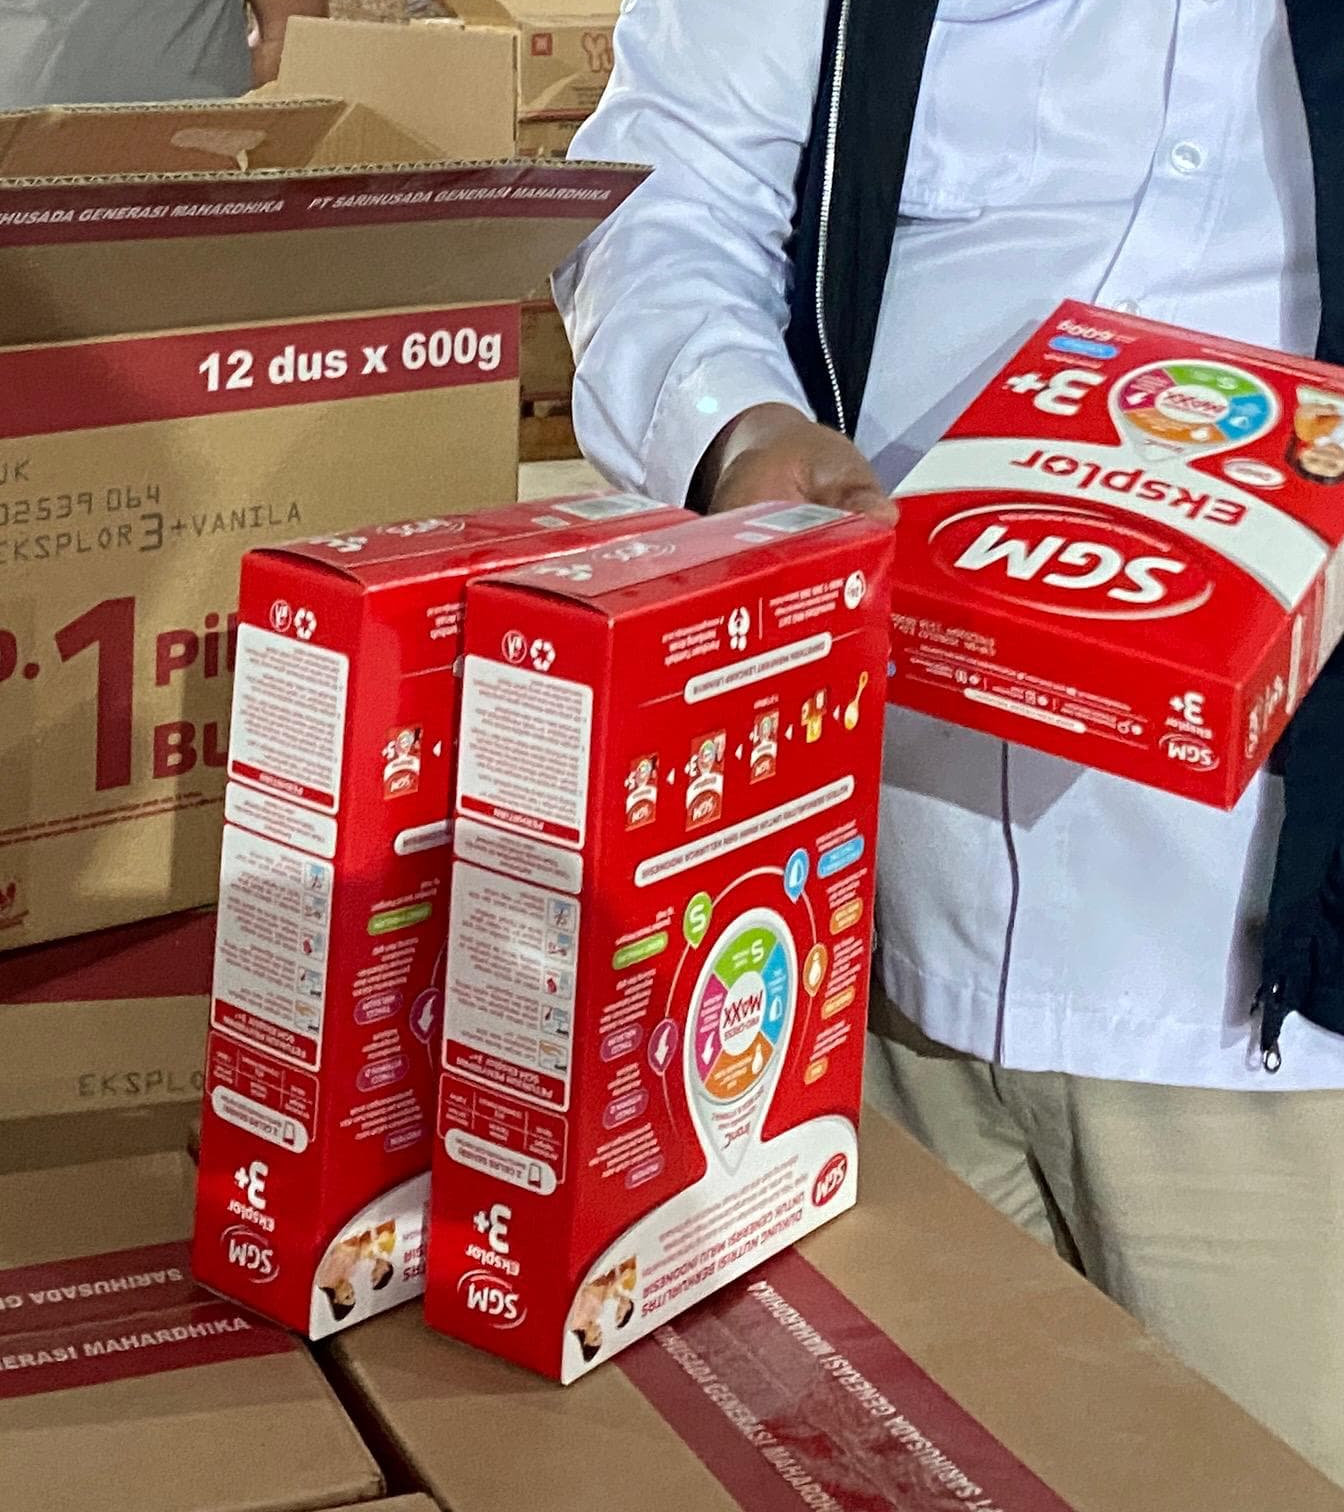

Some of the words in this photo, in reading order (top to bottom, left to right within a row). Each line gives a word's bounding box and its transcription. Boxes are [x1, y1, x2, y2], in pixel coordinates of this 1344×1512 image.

[78, 205, 169, 224] GENERASI
[173, 198, 285, 218] MAHARDHIKA
[307, 195, 329, 210] PT
[333, 190, 432, 209] SARIHUSADA
[434, 186, 510, 205] GENERASI
[511, 187, 611, 203] MAHARDHIKA
[198, 349, 254, 392] 12
[268, 345, 348, 385] dus
[361, 338, 388, 374] x
[401, 327, 503, 371] 600g
[1001, 368, 1106, 417] 3+
[1009, 448, 1250, 527] Eksplor
[953, 524, 1187, 605] SGM
[54, 596, 136, 791] 1
[1169, 691, 1206, 726] 3+
[1166, 741, 1215, 768] SGM
[722, 990, 764, 1028] MAXX
[234, 1160, 270, 1212] 3+
[815, 1159, 846, 1200] SGM
[226, 1197, 276, 1233] Eksplor
[473, 1202, 512, 1254] 3+
[227, 1238, 274, 1276] SGM
[464, 1243, 521, 1277] Eksplor
[28, 1266, 184, 1306] SARIHUSADA
[466, 1282, 521, 1320] SGM
[83, 1316, 253, 1358] MAHARDHIKA
